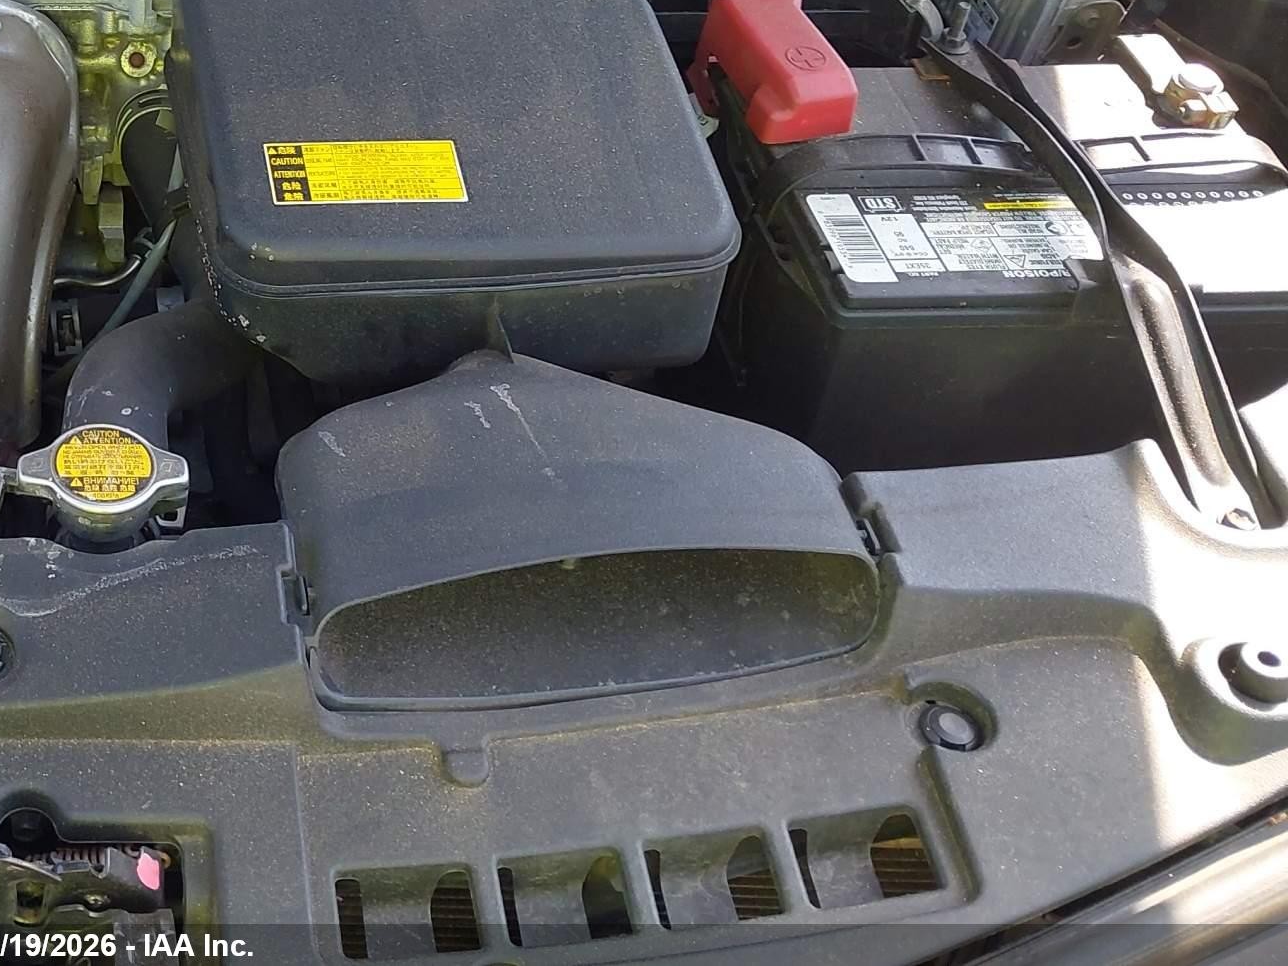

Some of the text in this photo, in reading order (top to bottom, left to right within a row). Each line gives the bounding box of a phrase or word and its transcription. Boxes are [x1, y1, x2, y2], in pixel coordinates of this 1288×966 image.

[271, 157, 304, 166] CAUTION
[274, 170, 306, 179] ATTENTION
[865, 197, 897, 210] STD
[83, 477, 139, 485] ВНИМАНИЕ!
